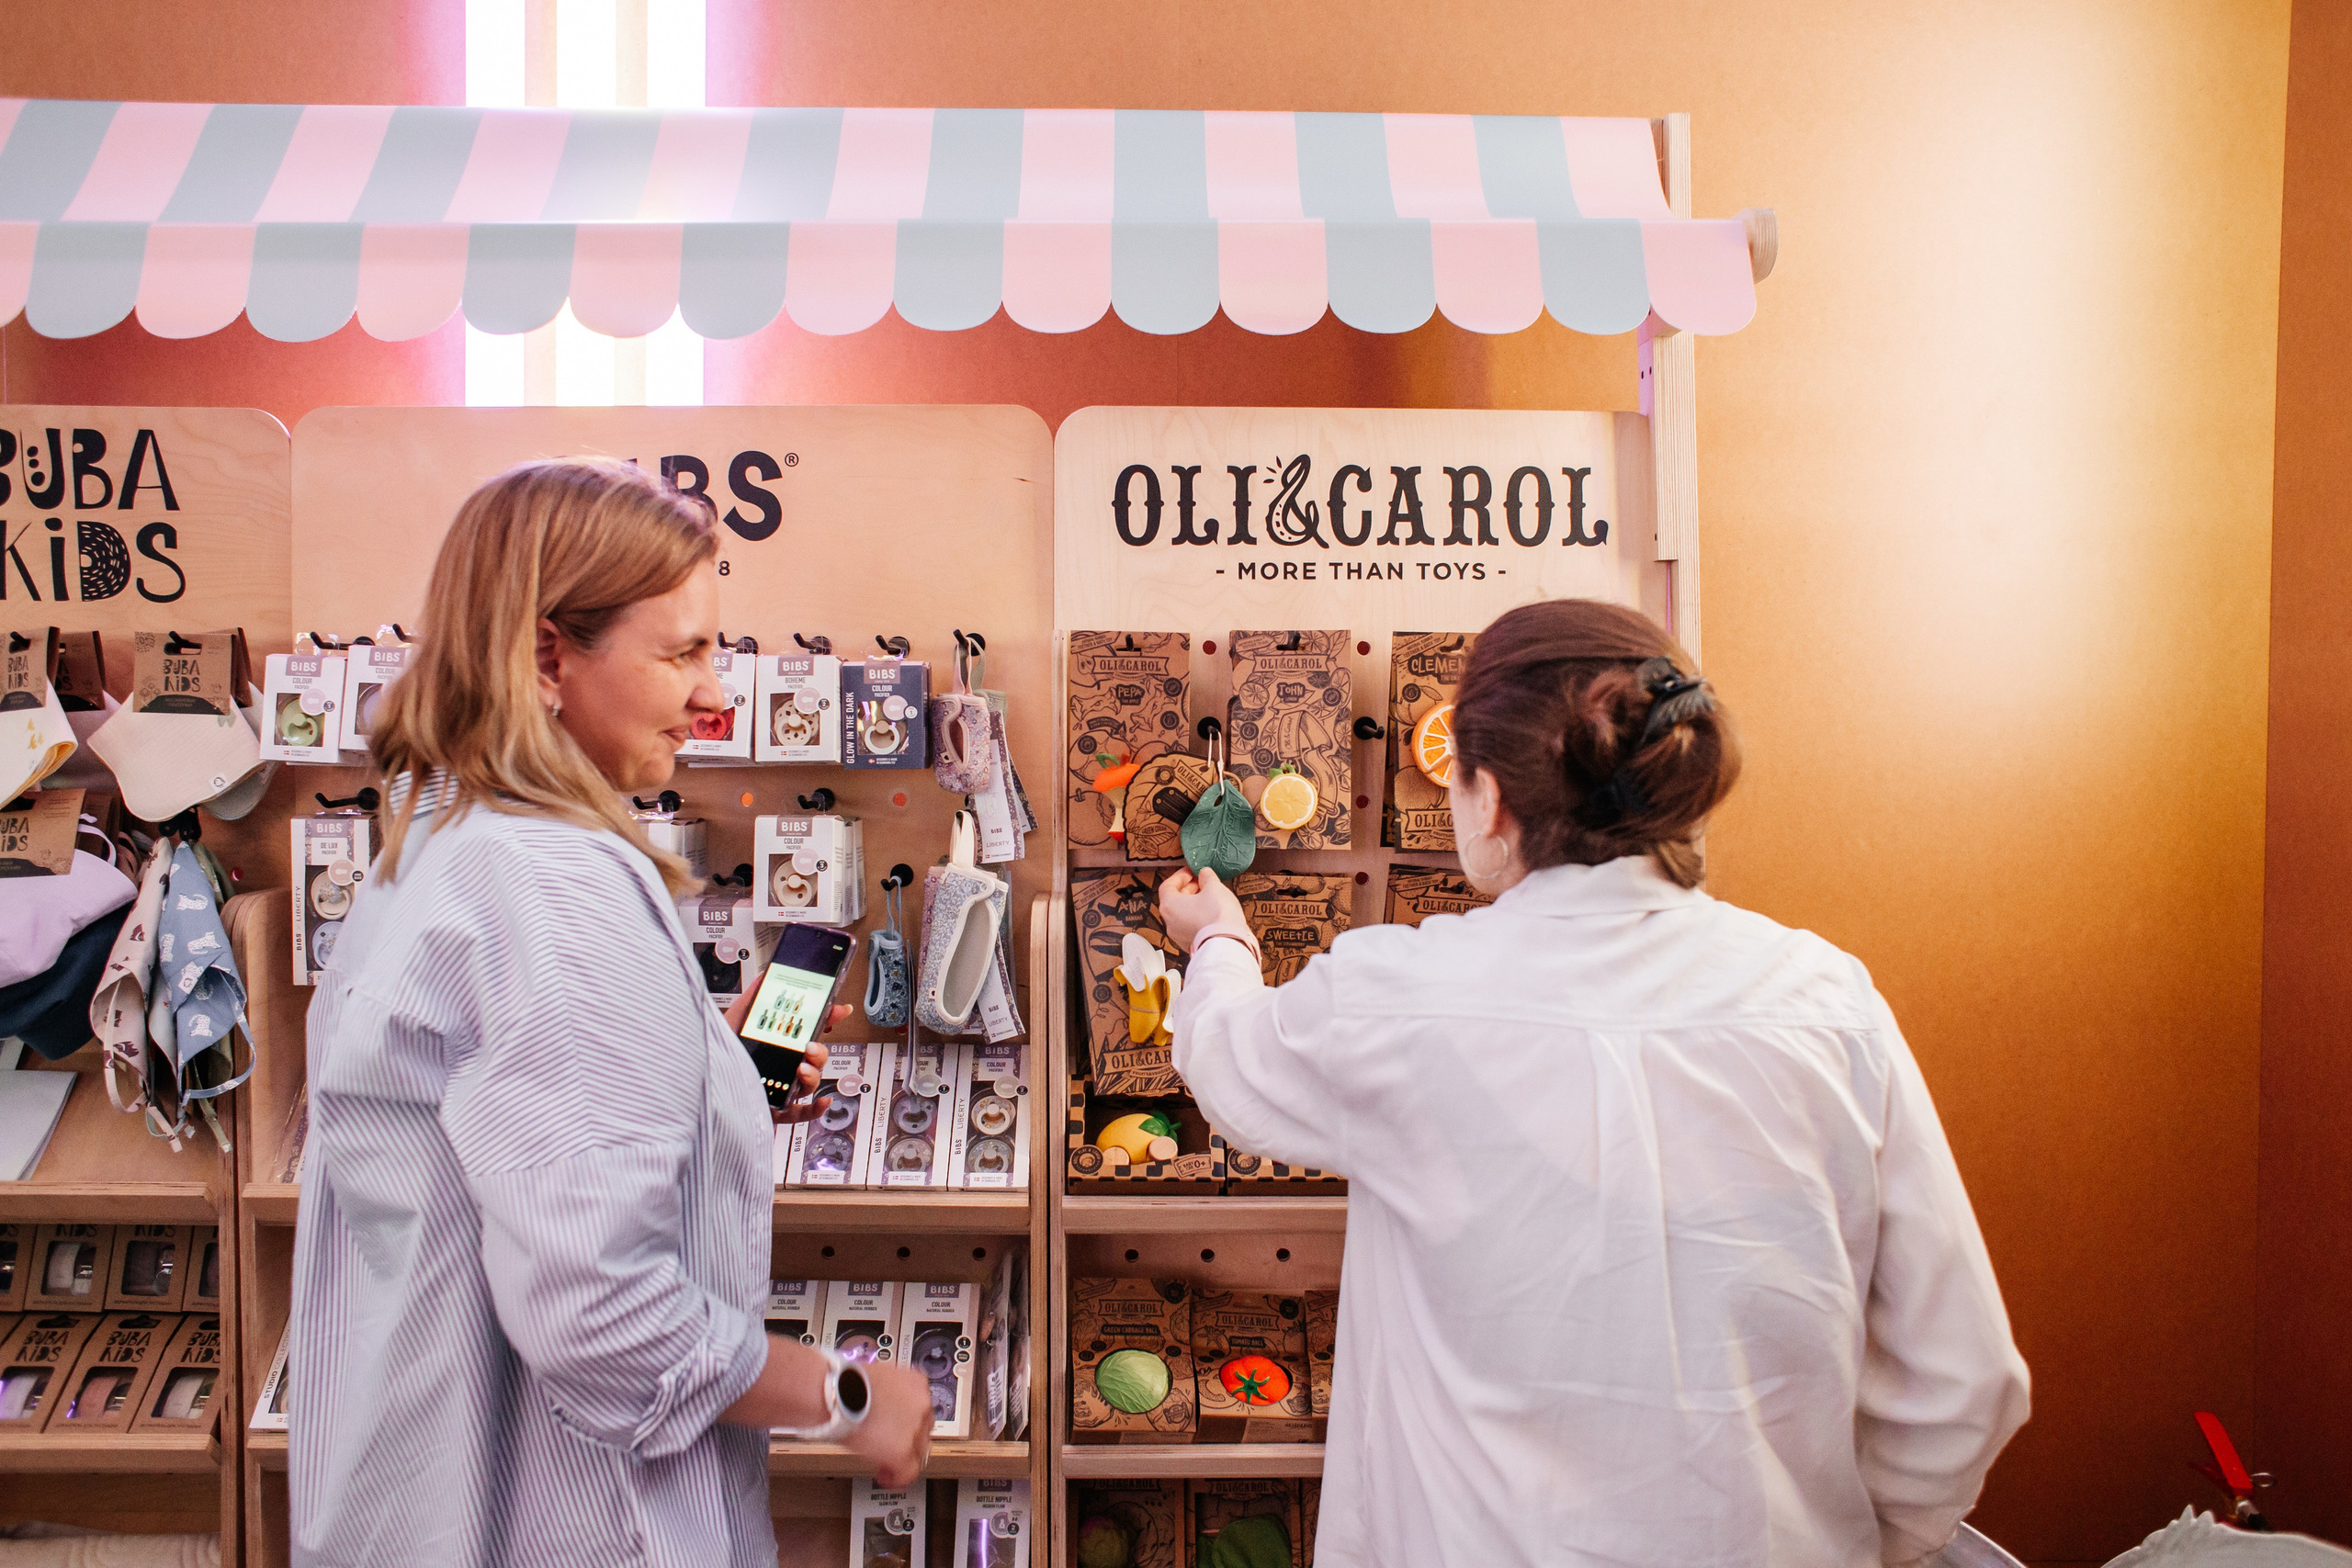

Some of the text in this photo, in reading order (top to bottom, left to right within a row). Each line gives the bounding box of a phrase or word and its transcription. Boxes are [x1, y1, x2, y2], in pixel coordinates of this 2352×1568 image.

[1111, 454, 1609, 549] OLI&CAROL
[1238, 562, 1486, 581] MORE THAN TOYS
[375, 651, 401, 662] BIBS
[291, 661, 318, 671] BIBS
[783, 660, 809, 671] BIBS
[1099, 659, 1161, 671] OLI&CAROL
[1260, 658, 1322, 670] OLI&CAROL
[1411, 656, 1466, 673] CLEMEN
[869, 669, 896, 679] BIBS
[1118, 686, 1143, 697] PEPA
[1279, 685, 1304, 696] JOHN
[846, 692, 854, 713] DARK
[846, 716, 854, 729] THE
[847, 741, 855, 764] GLOW
[1415, 813, 1453, 827] OLI&C
[316, 823, 343, 833] BIBS
[781, 821, 808, 831] BIBS
[1261, 903, 1322, 916] OLI&CAROL
[703, 911, 729, 921] BIBS
[988, 1017, 1009, 1027] LIBERTY
[831, 1045, 856, 1054] BIBS
[877, 1097, 887, 1128] LIBERTY
[957, 1098, 966, 1130] LIBERTY
[776, 1282, 801, 1292] BIBS
[854, 1283, 878, 1292] BIBS
[930, 1285, 955, 1294] BIBS
[1104, 1303, 1158, 1314] OLI&CAROL
[1222, 1315, 1273, 1327] OLI&CAROL
[264, 1371, 277, 1399] STUDIO
